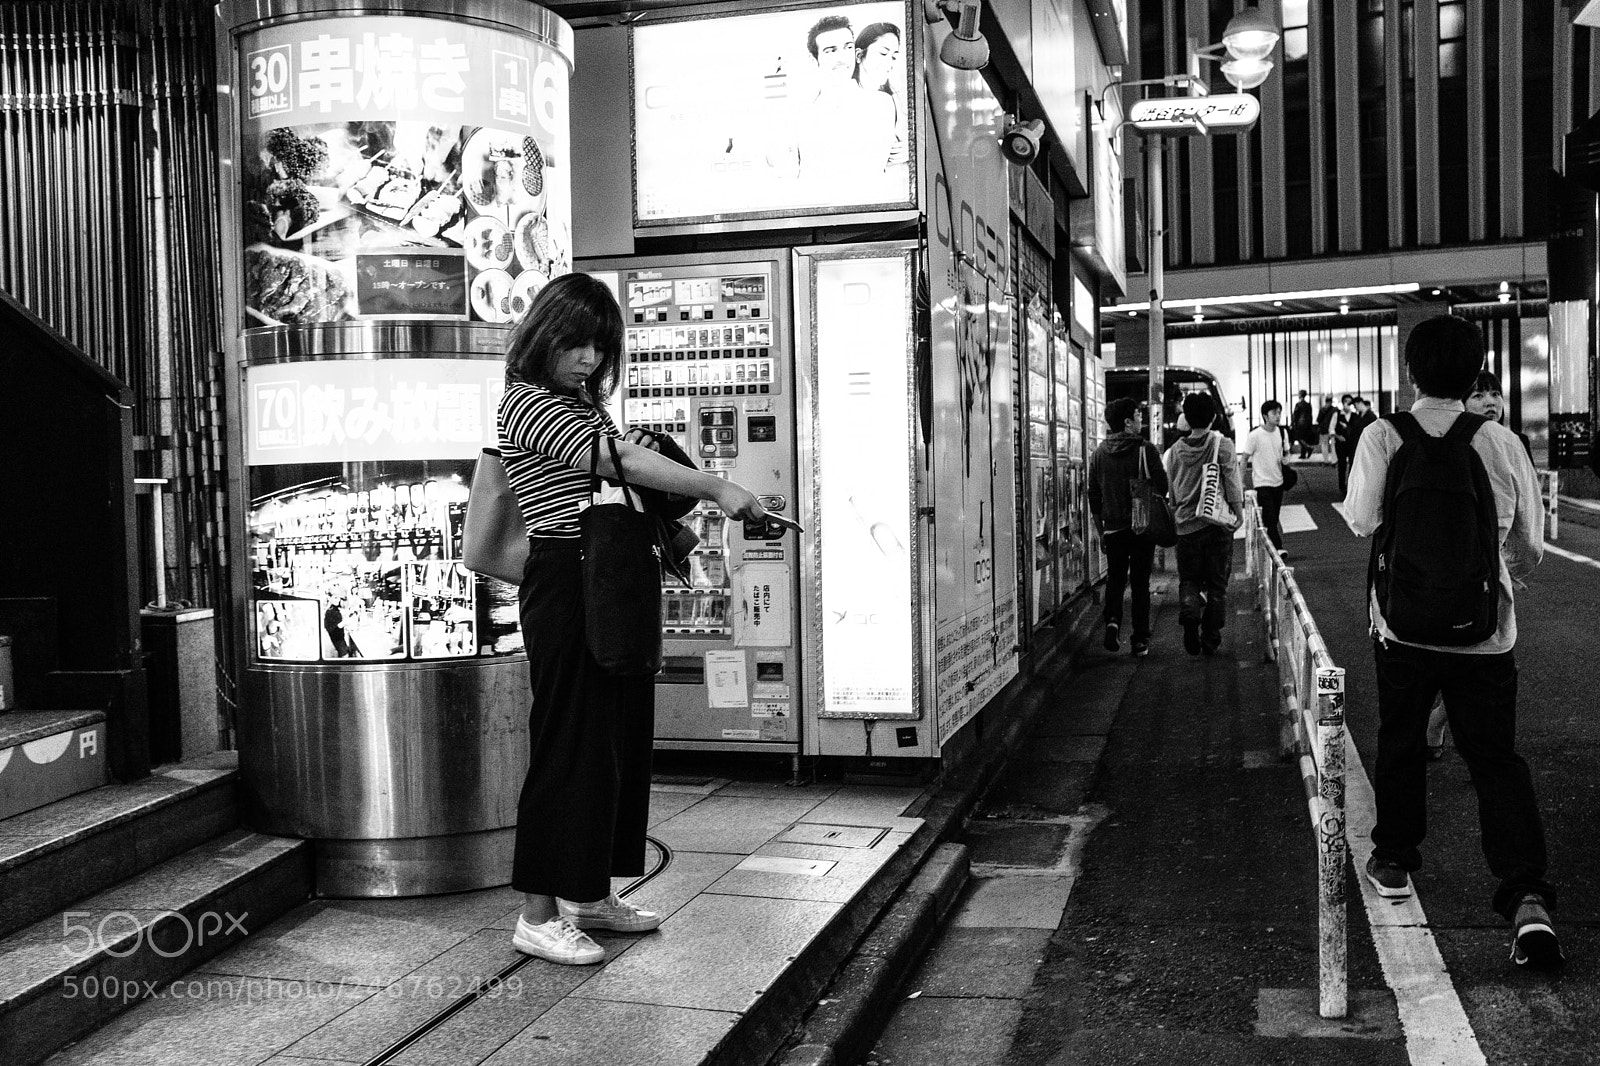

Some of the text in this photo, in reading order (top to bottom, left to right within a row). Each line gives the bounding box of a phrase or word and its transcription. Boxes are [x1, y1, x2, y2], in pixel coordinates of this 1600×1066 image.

[250, 52, 288, 97] 30
[298, 33, 471, 113] 串焼き
[383, 258, 440, 268] 土曜日 日曜日
[258, 387, 297, 429] 70
[302, 381, 483, 446] 飲み放題
[79, 730, 97, 759] 円
